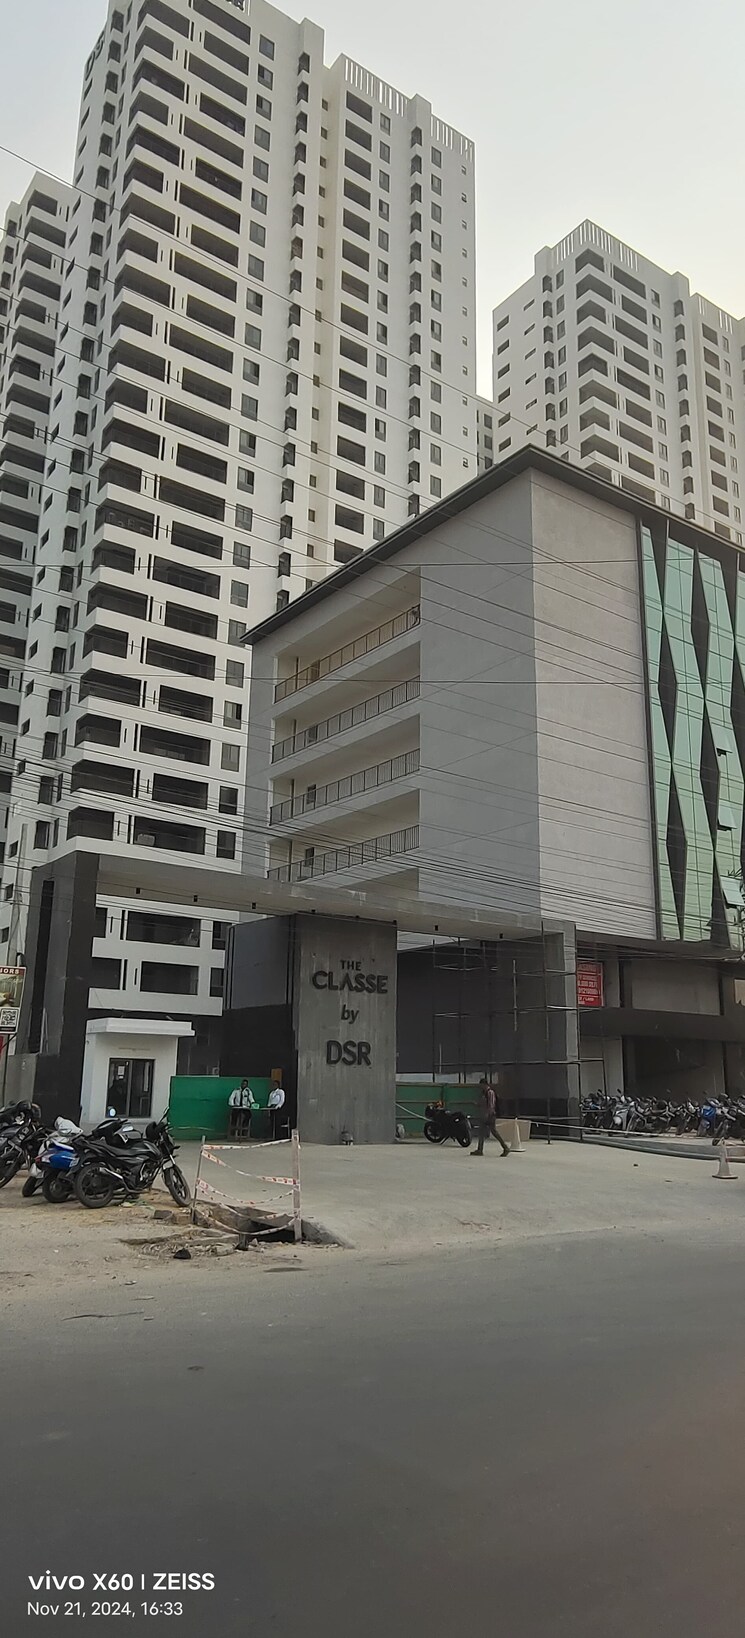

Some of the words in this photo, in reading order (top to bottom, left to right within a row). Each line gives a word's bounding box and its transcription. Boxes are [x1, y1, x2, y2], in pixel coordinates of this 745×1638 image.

[340, 960, 362, 971] THE
[312, 970, 388, 994] CLASSE
[340, 1004, 360, 1024] by
[326, 1040, 372, 1066] DSR
